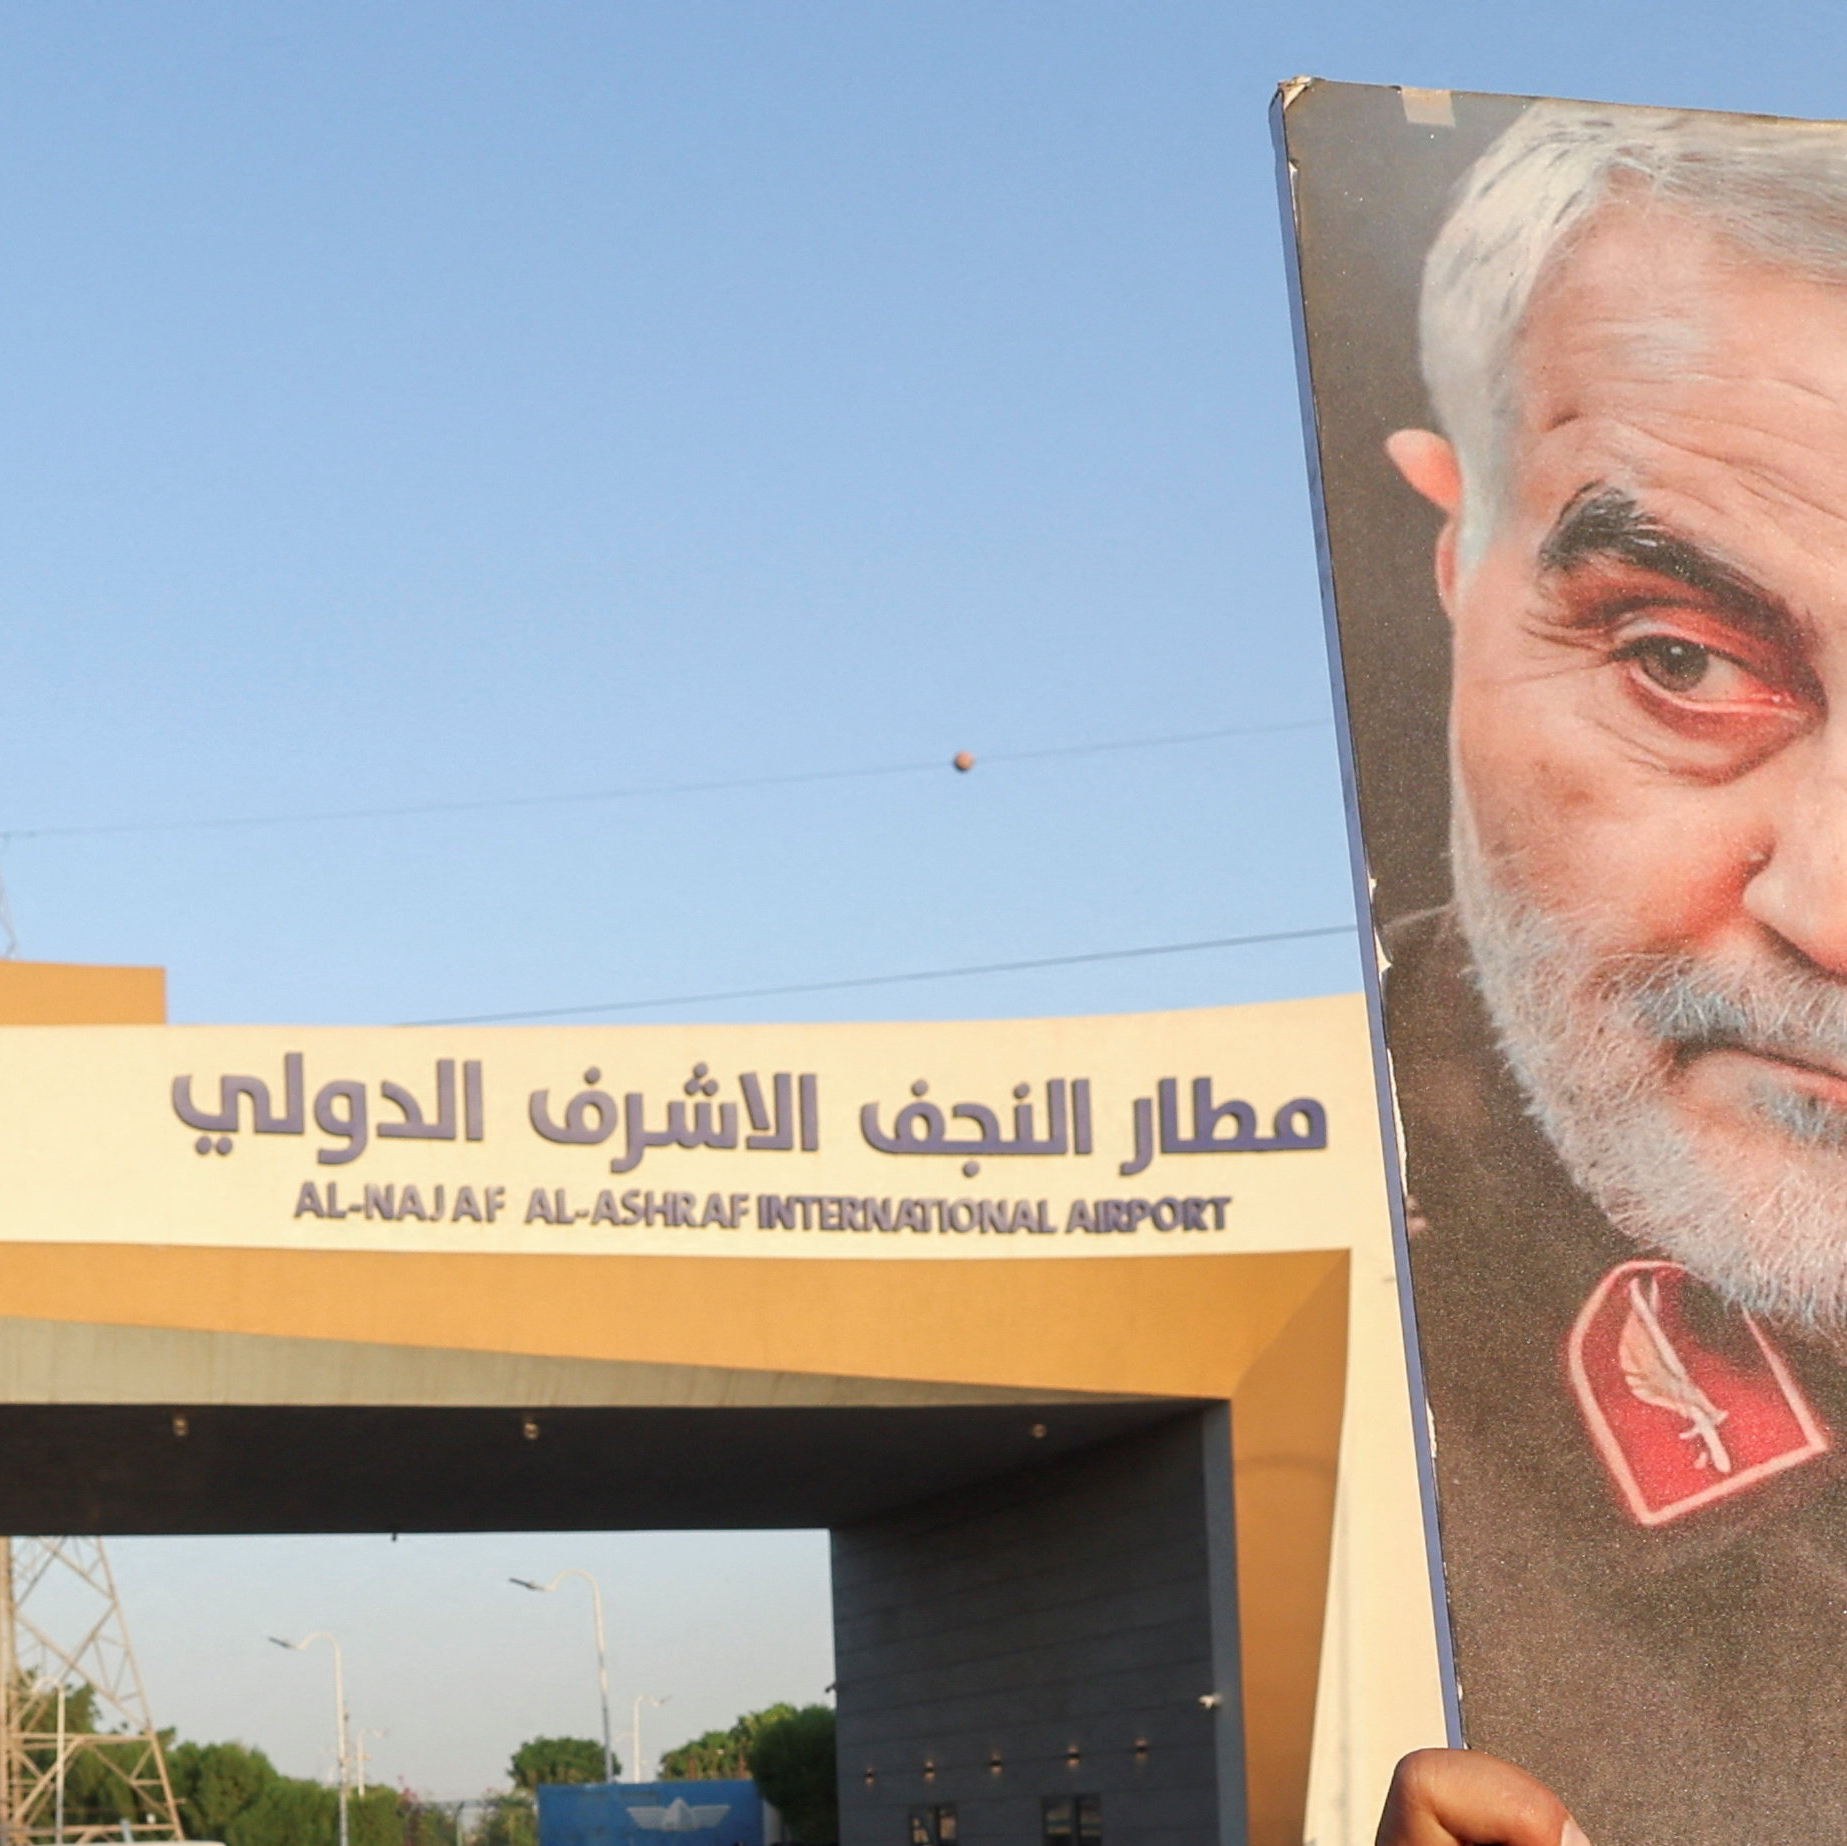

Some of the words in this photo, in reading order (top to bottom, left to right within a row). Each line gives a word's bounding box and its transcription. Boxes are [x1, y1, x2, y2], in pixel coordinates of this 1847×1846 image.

[171, 1052, 484, 1165] الدولي
[528, 1062, 819, 1174] الاشرف
[860, 1078, 1093, 1178] النجف
[1119, 1077, 1328, 1177] مطار
[294, 1181, 505, 1223] AL-NAJAF
[525, 1188, 750, 1229] AL-ASHRAF
[757, 1194, 1058, 1234] INTERNATIONAL
[1065, 1196, 1232, 1234] AIRPORT
